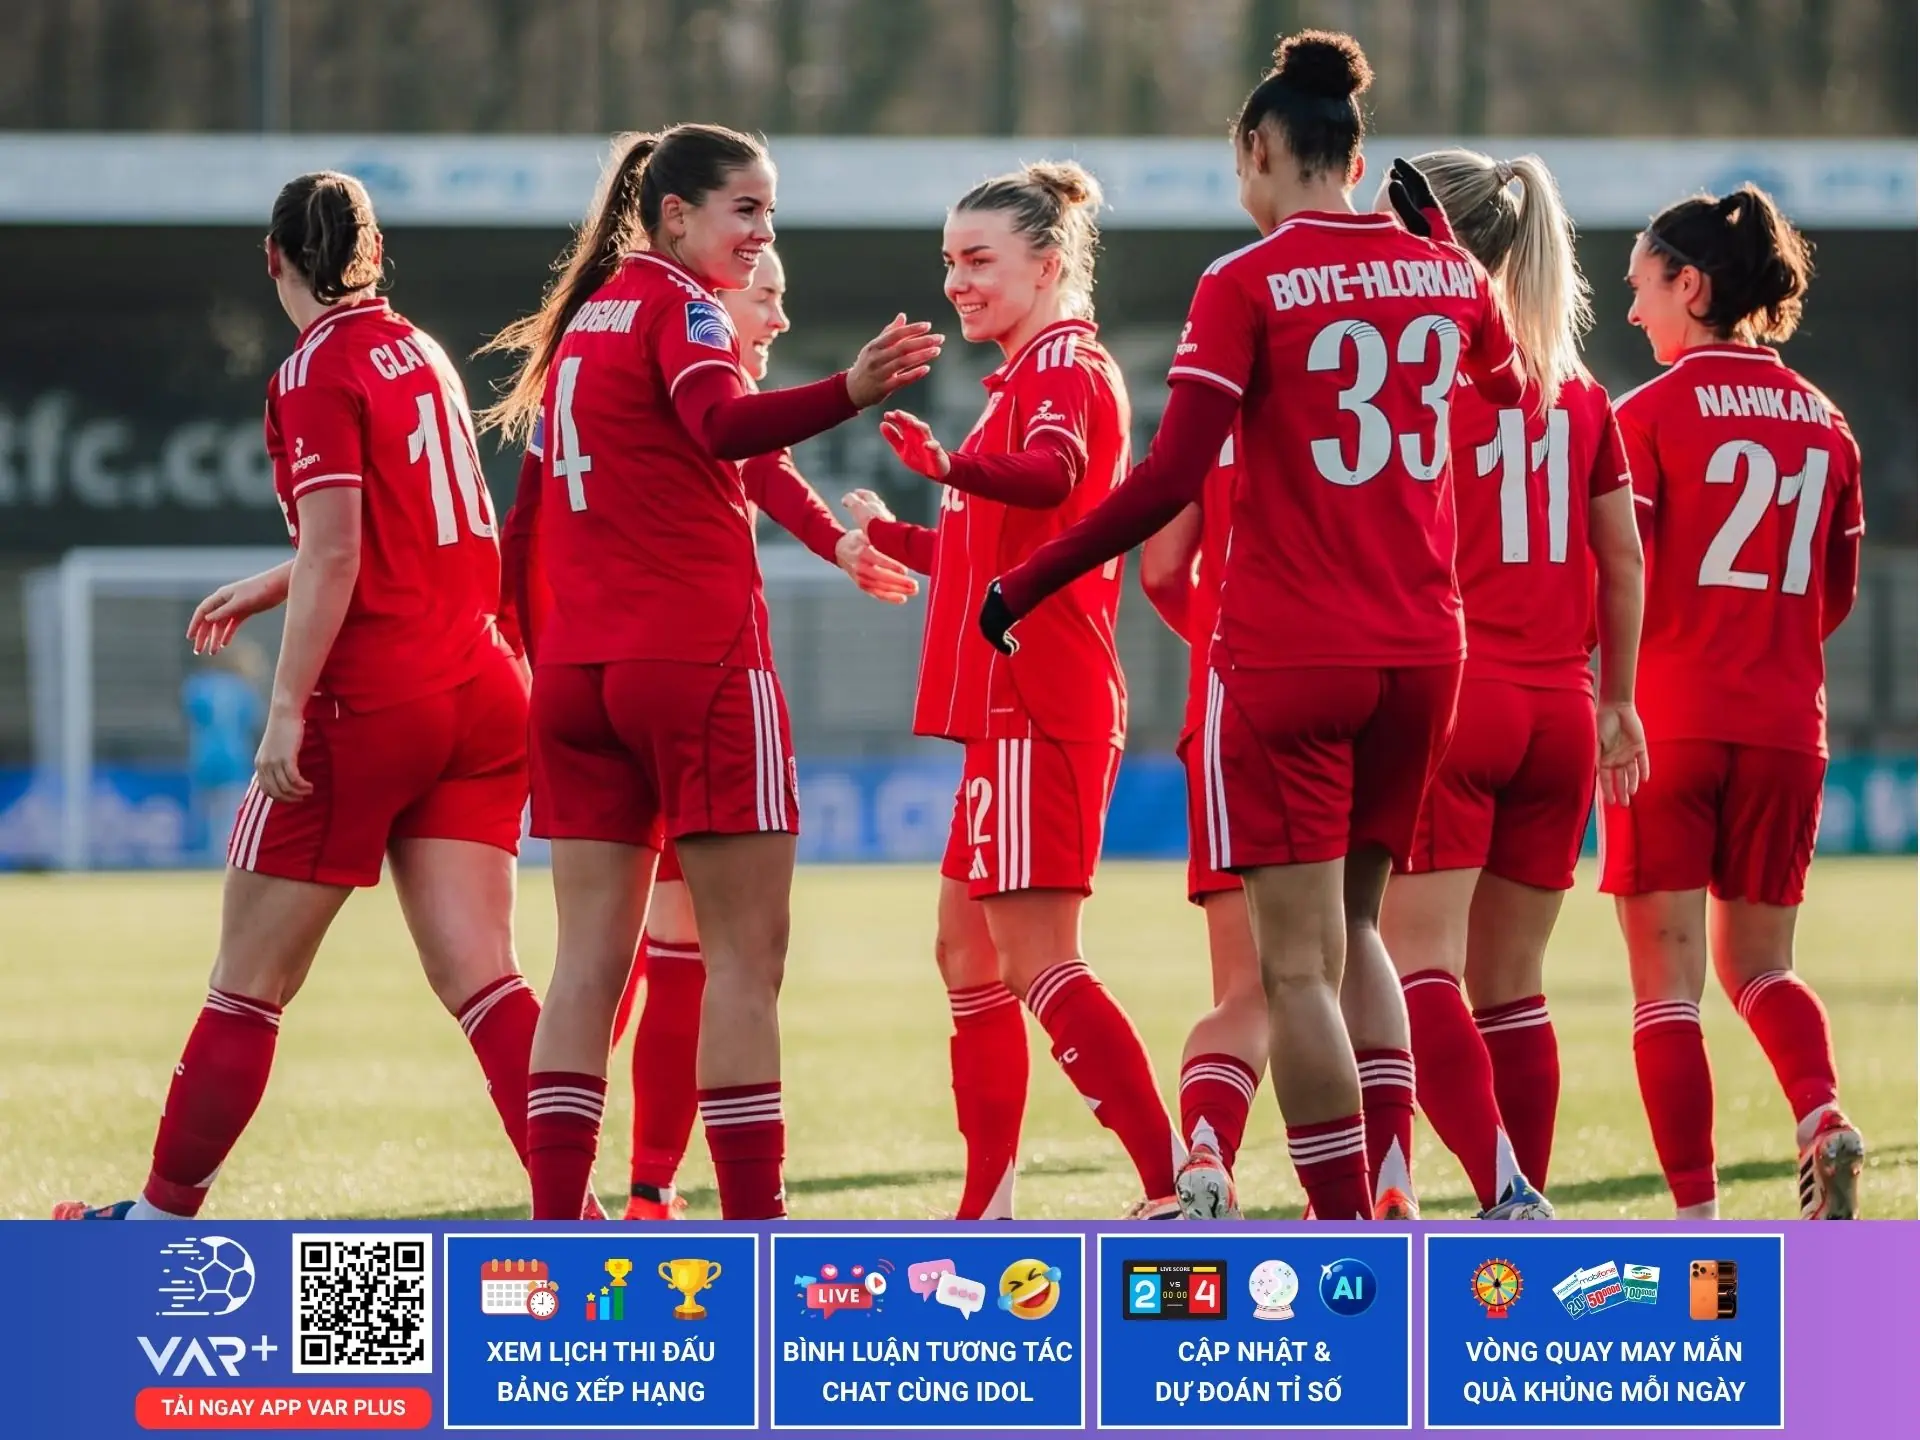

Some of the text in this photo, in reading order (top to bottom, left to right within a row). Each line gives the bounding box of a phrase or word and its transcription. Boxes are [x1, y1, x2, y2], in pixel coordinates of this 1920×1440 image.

[1267, 260, 1478, 312] BOYE-HLORKAH
[407, 391, 497, 546] 10
[553, 356, 592, 512] 4
[1306, 314, 1461, 486] 33
[1476, 408, 1570, 563] 11
[1698, 439, 1830, 596] 21
